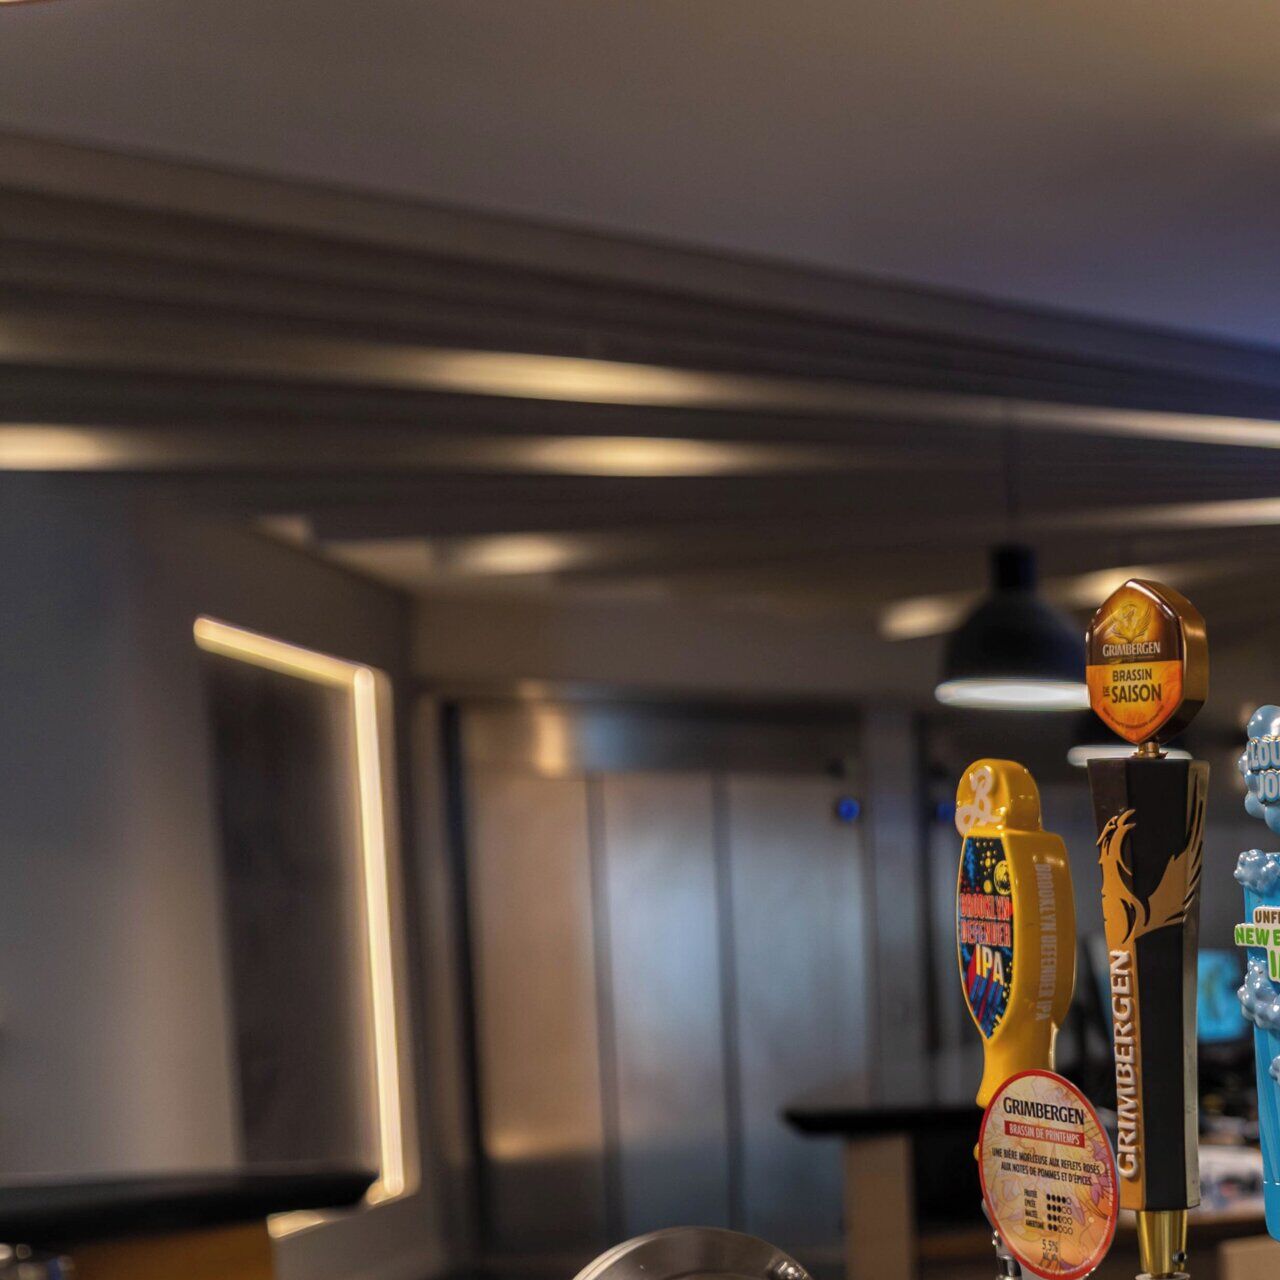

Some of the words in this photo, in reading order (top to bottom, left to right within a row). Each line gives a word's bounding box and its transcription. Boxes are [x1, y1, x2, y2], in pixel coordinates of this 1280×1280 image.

[1102, 641, 1161, 657] GRIMBERGEN
[1112, 668, 1153, 682] BRASSIN
[1111, 683, 1162, 704] SAISON
[959, 893, 1011, 920] BROOKLYN
[1035, 863, 1056, 930] BROOKLYN
[960, 919, 1012, 947] DEFENDER
[1235, 926, 1270, 946] NEW
[975, 944, 1005, 986] IPA
[1038, 935, 1057, 1001] DEFENDER
[1035, 1001, 1052, 1021] IPA
[1110, 949, 1139, 1178] GRIMBERGEN
[1003, 1096, 1084, 1125] GRIMBERGEN
[1009, 1122, 1035, 1138] BRASSIN
[1035, 1127, 1044, 1139] DE
[1045, 1129, 1080, 1145] PRINTEMPS
[991, 1147, 1003, 1158] UNE
[1003, 1148, 1018, 1160] BIÈRE
[1049, 1156, 1060, 1167] AUX
[1060, 1158, 1081, 1172] REFLETS
[1001, 1161, 1012, 1171] AUX
[1012, 1163, 1028, 1175] NOTES
[1029, 1166, 1037, 1176] DE
[1037, 1167, 1061, 1180] POMMES
[1061, 1170, 1068, 1181] ET
